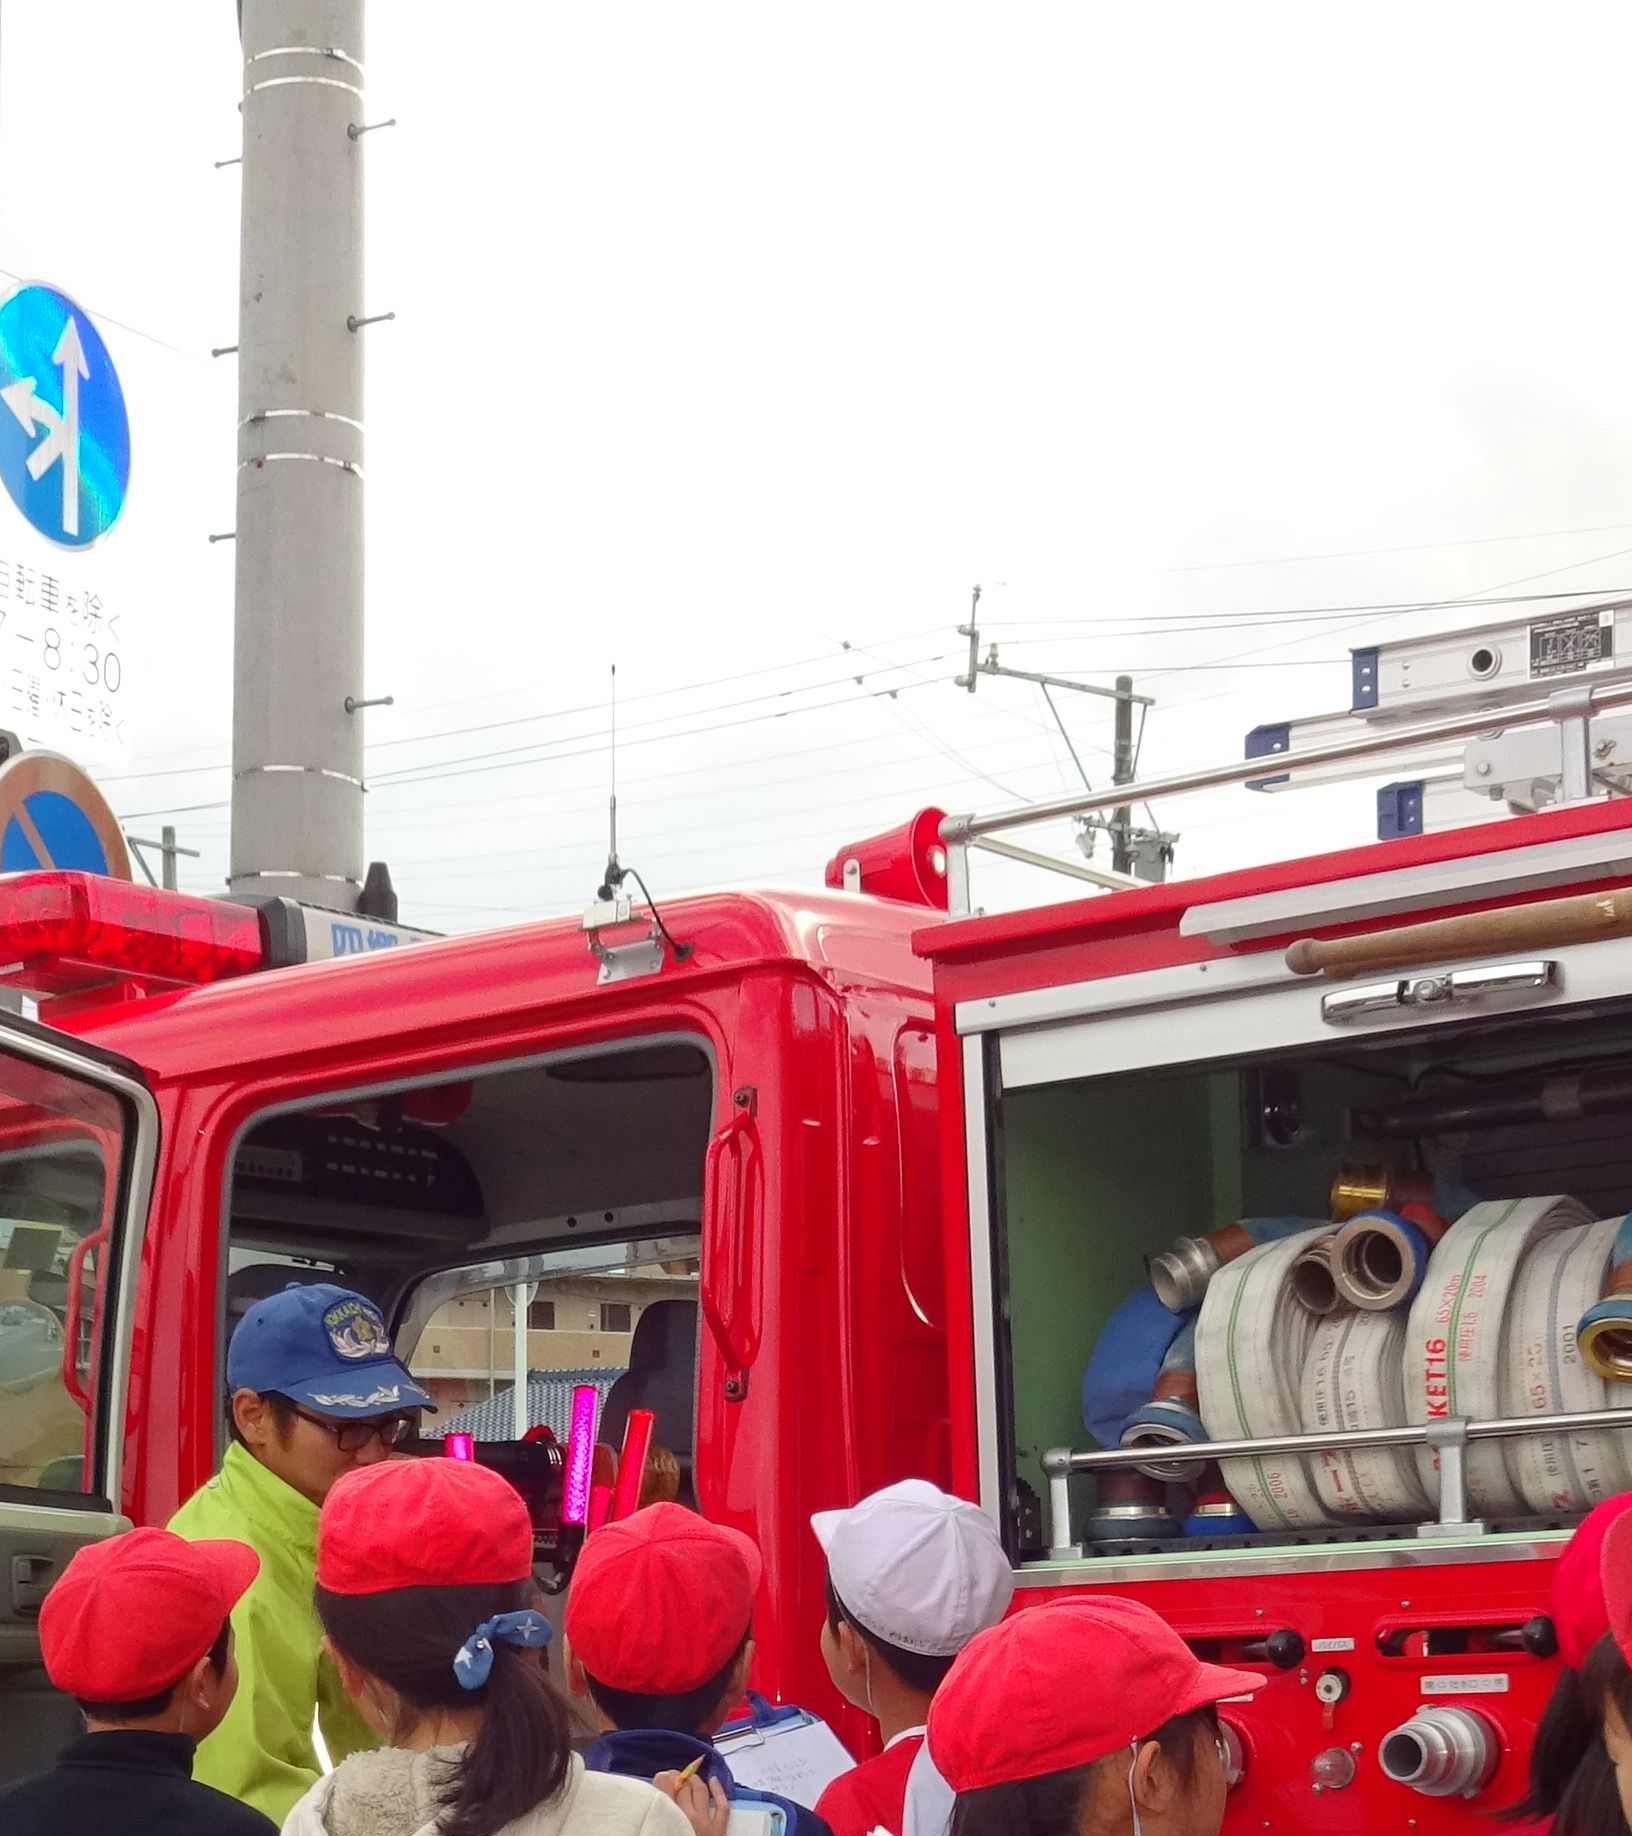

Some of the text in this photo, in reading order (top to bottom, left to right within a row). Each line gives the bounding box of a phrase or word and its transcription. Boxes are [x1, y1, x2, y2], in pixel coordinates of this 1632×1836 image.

[1466, 1273, 1489, 1299] 2004
[1561, 1323, 1578, 1365] 2001
[1266, 1471, 1289, 1500] 2006
